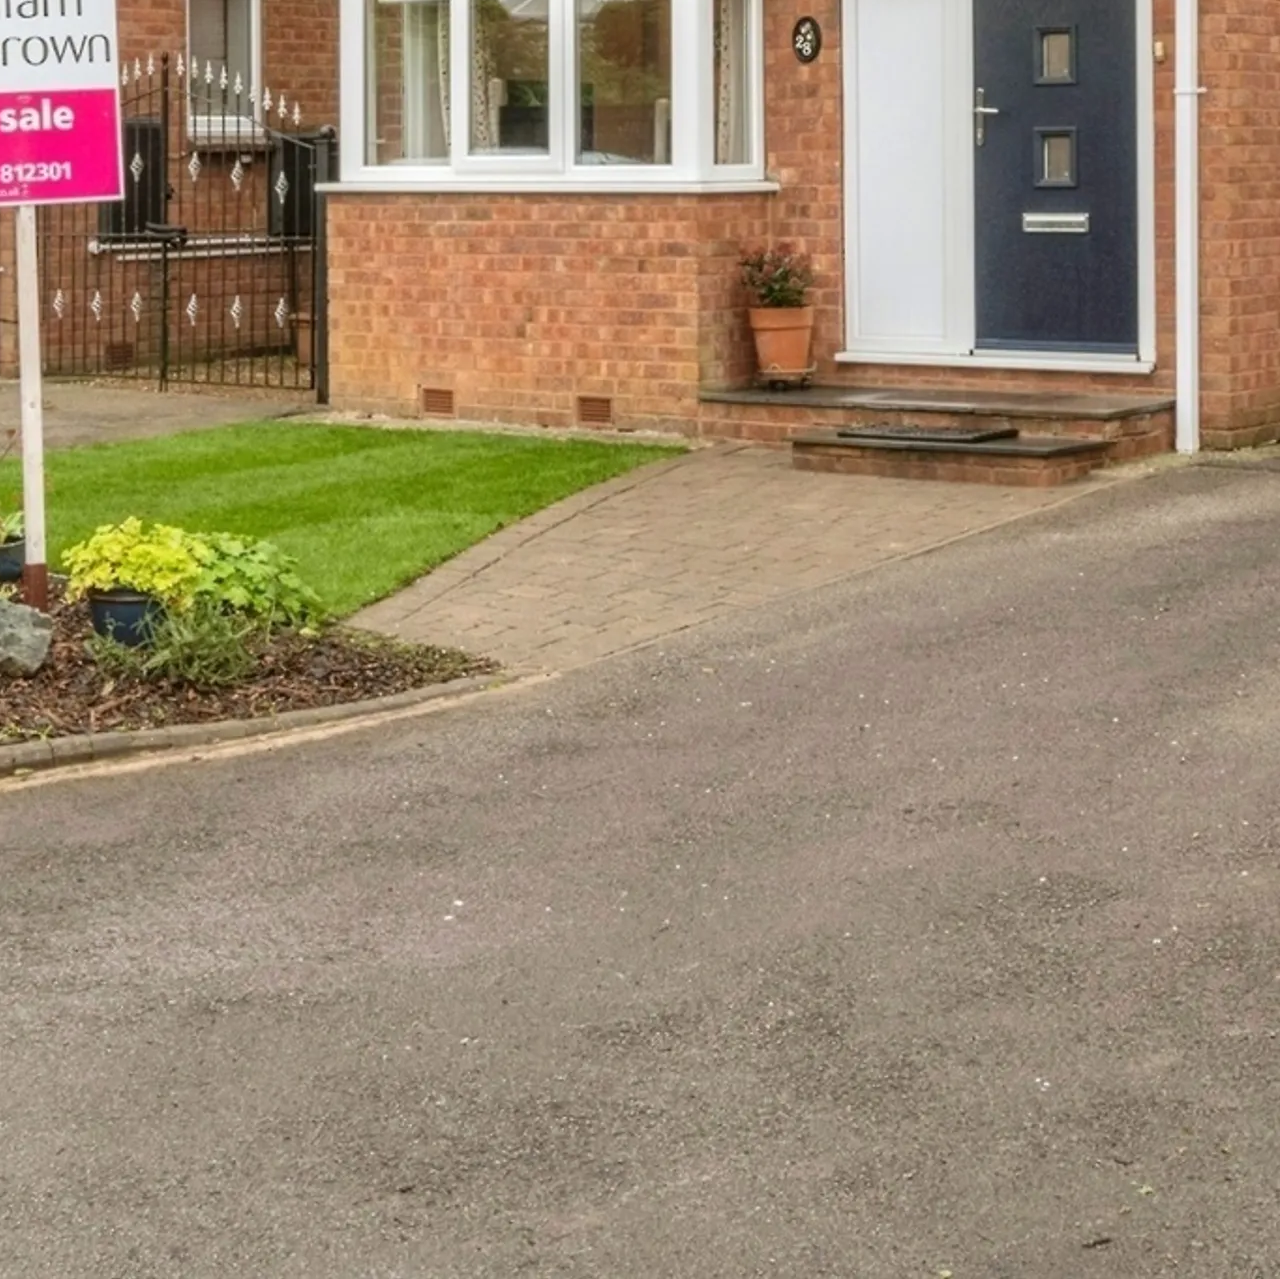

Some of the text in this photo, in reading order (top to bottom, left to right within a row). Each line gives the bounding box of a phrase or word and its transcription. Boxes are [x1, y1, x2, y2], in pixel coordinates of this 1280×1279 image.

[795, 35, 812, 55] 28
[0, 99, 75, 133] sale
[0, 161, 72, 184] 812301
